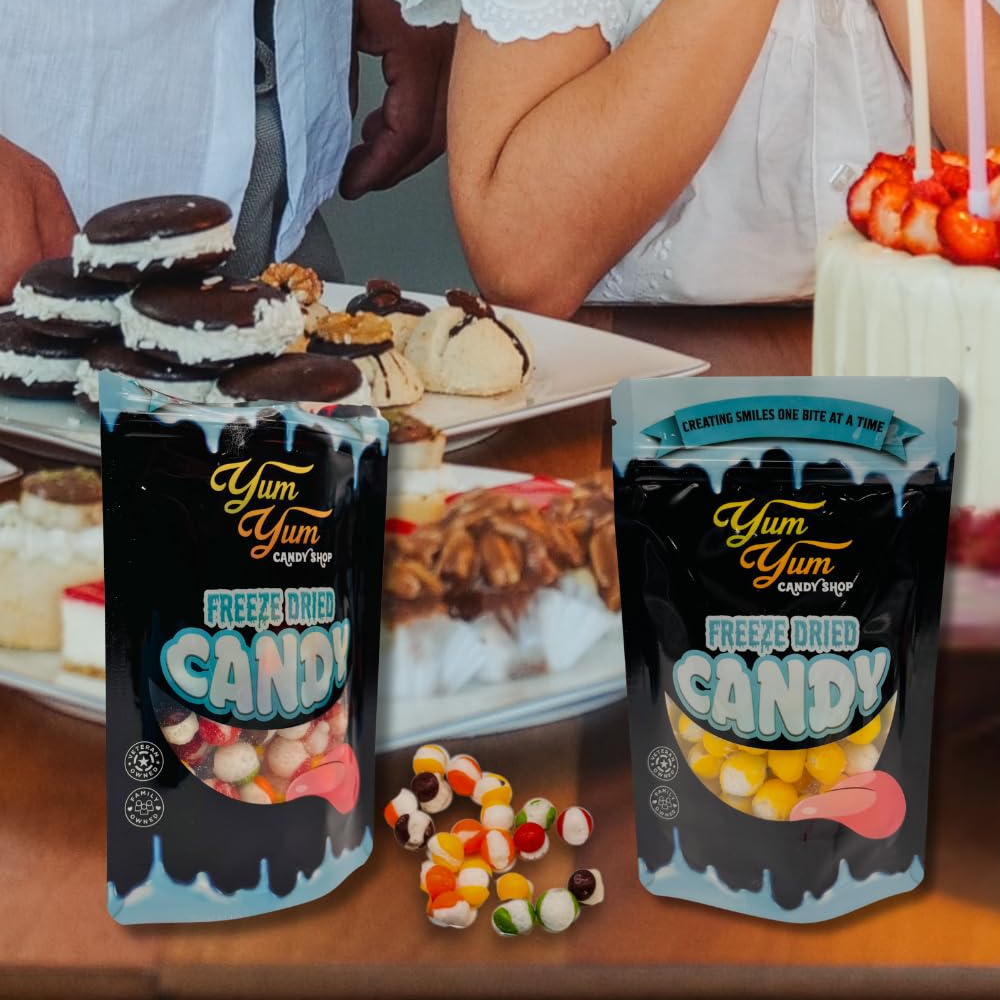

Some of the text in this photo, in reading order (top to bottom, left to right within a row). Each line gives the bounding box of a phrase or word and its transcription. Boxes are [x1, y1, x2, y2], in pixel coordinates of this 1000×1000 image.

[682, 408, 886, 433] CREATING SMILES ONE BITE AT A TIME
[210, 457, 314, 514] Yum
[237, 504, 333, 560] Yum
[712, 497, 826, 549] Yum
[272, 548, 333, 568] CANDY SHOP
[739, 538, 854, 590] Yum
[777, 578, 854, 597] CANDY SHOP
[204, 587, 336, 632] FREEZE DRIED
[705, 615, 860, 656] FREEZE DRIED
[160, 618, 351, 722] CANDY
[672, 646, 891, 742] CANDY
[128, 744, 160, 760] VETERAN
[130, 766, 159, 779] OWNED
[130, 790, 160, 802] FAMILY
[130, 813, 159, 825] OWNED
